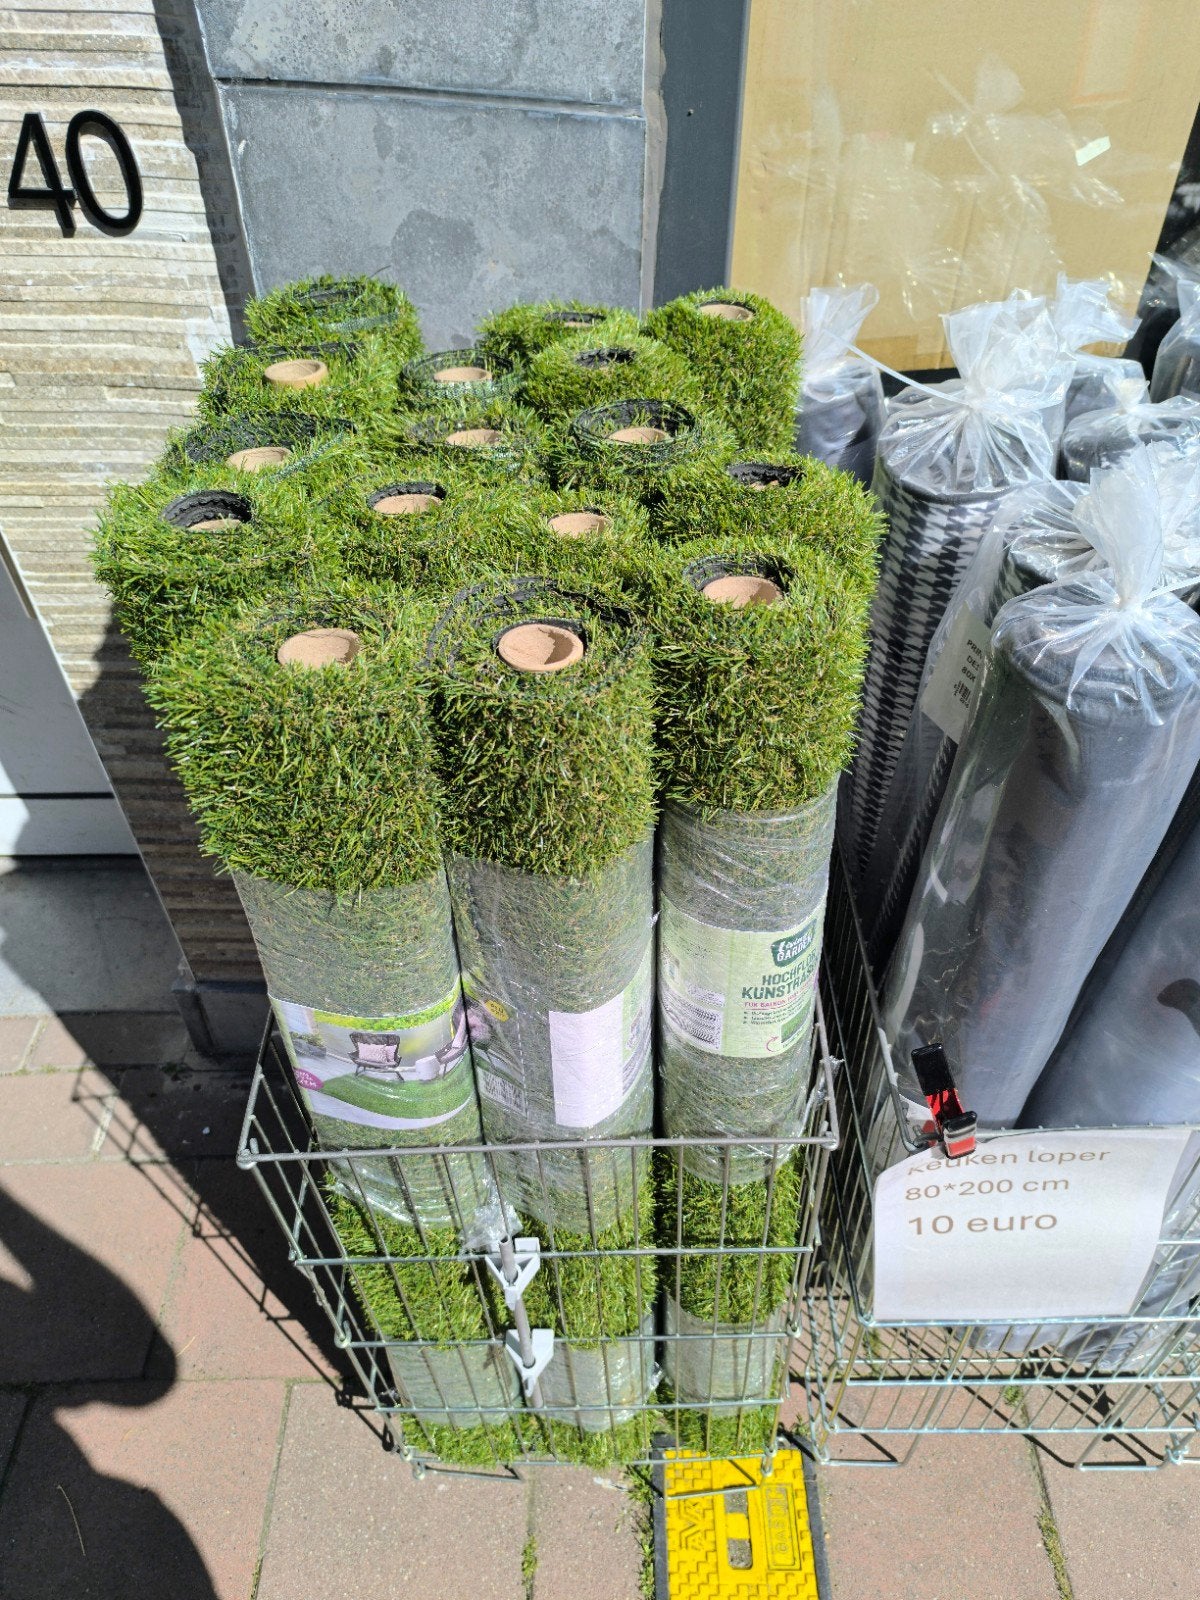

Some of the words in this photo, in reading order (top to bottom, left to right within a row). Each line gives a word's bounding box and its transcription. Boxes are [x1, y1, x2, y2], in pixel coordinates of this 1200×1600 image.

[8, 109, 143, 238] 40
[1028, 1149, 1111, 1166] loper
[1022, 1178, 1070, 1193] cm
[908, 1214, 954, 1236] 10
[966, 1213, 1058, 1233] euro
